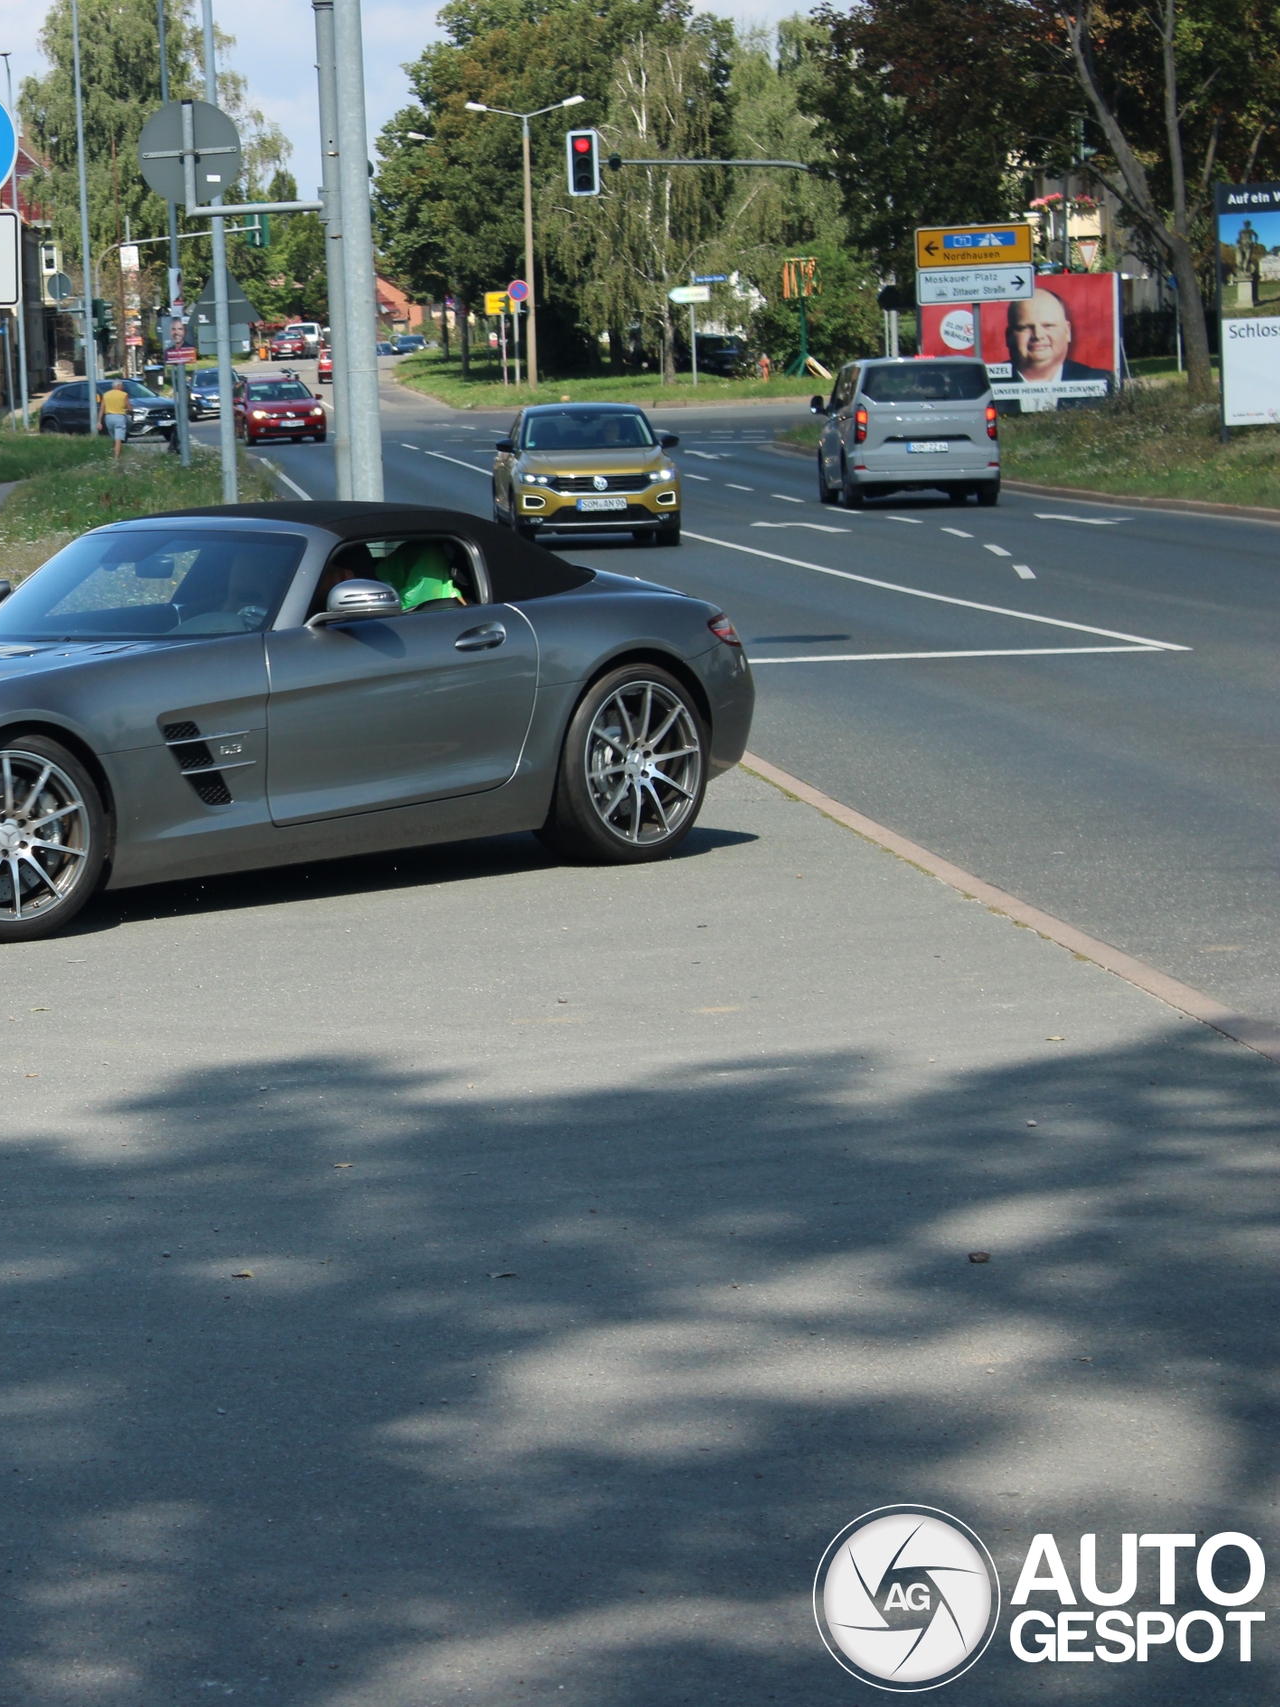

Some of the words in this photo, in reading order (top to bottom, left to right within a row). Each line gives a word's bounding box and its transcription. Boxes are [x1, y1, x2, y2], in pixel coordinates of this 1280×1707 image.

[1227, 192, 1249, 204] Auf
[1250, 192, 1270, 203] ein
[943, 251, 1000, 261] Nordhausen
[925, 274, 970, 284] Moskauer
[975, 273, 998, 282] Platz
[952, 287, 980, 297] Zittauer
[983, 285, 1006, 295] Straße
[993, 388, 1020, 396] UNSERE
[1052, 385, 1068, 394] IHRE
